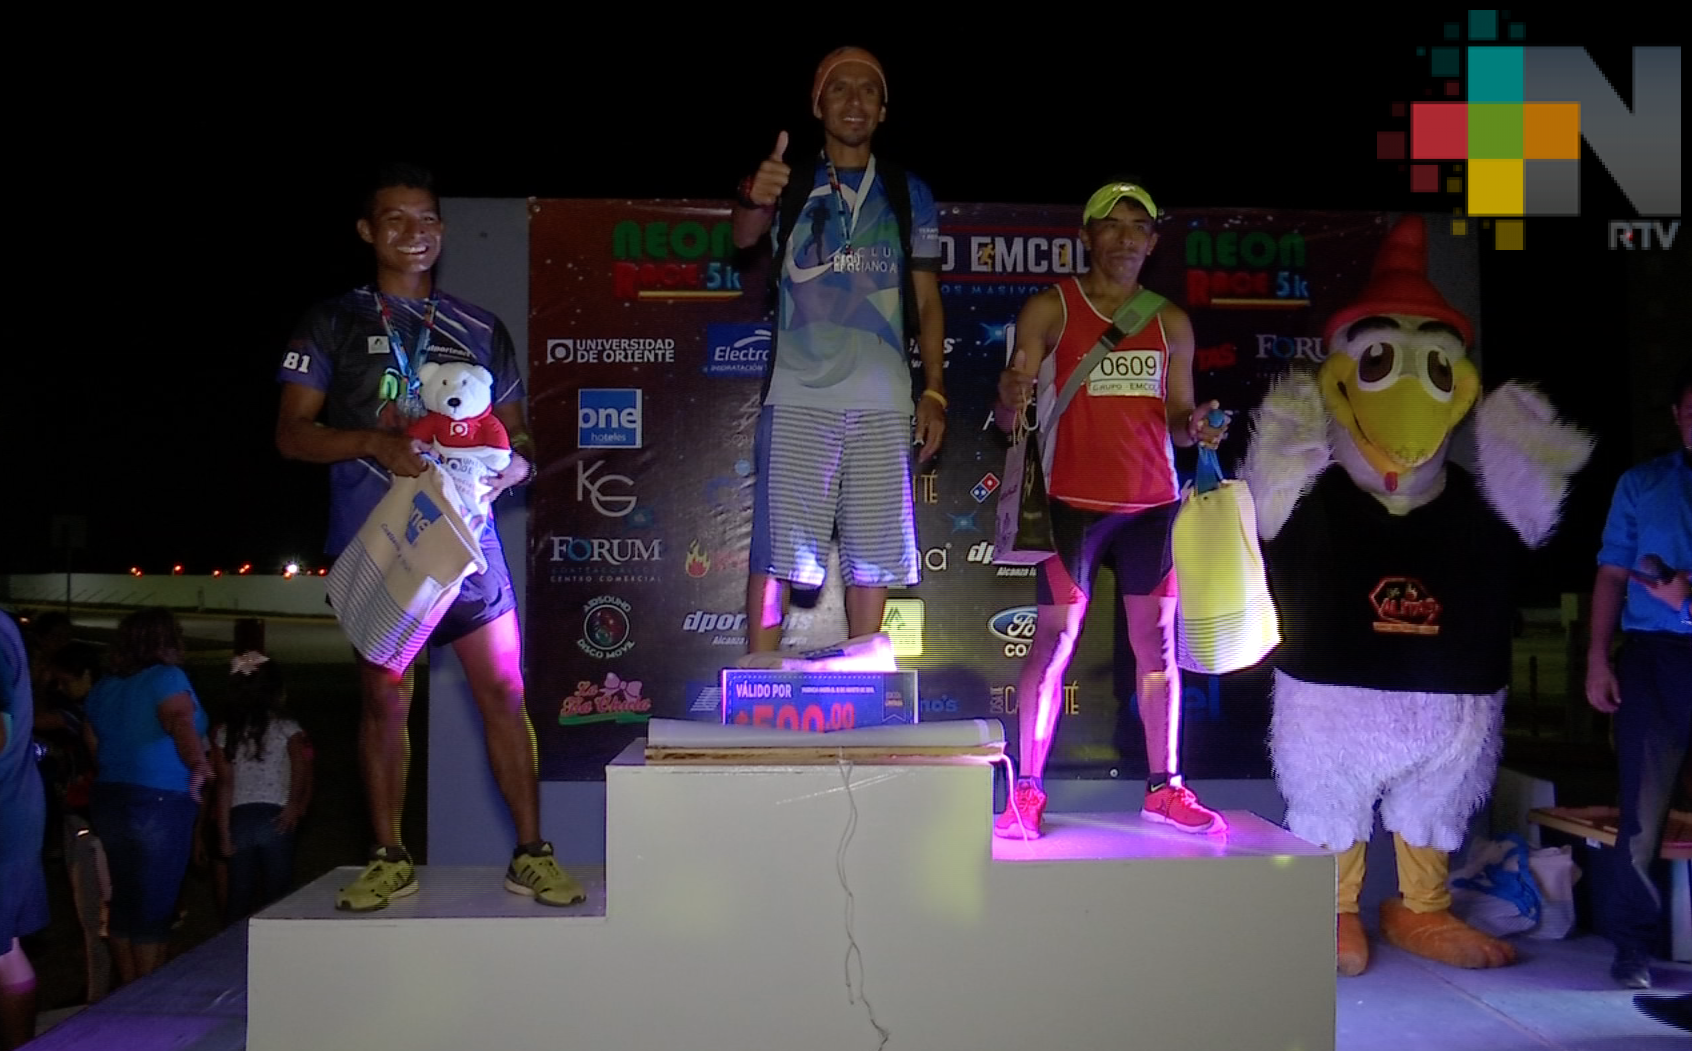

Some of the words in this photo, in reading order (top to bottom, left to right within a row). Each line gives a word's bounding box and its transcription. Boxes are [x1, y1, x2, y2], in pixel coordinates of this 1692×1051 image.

[1186, 230, 1306, 267] NEON
[576, 338, 675, 350] UNIVERSIDAD
[283, 351, 311, 373] 81
[577, 350, 599, 363] DE
[602, 350, 675, 363] ORIENTE
[1100, 355, 1157, 376] 0609
[580, 406, 637, 429] one
[590, 431, 627, 442] hoteles
[576, 459, 638, 518] KG
[550, 536, 663, 566] FORUM
[550, 575, 593, 583] CENTRO
[599, 575, 661, 583] COMERCIAL
[577, 639, 604, 659] DISCO
[736, 679, 771, 698] VÁLIDO
[772, 683, 792, 698] POR
